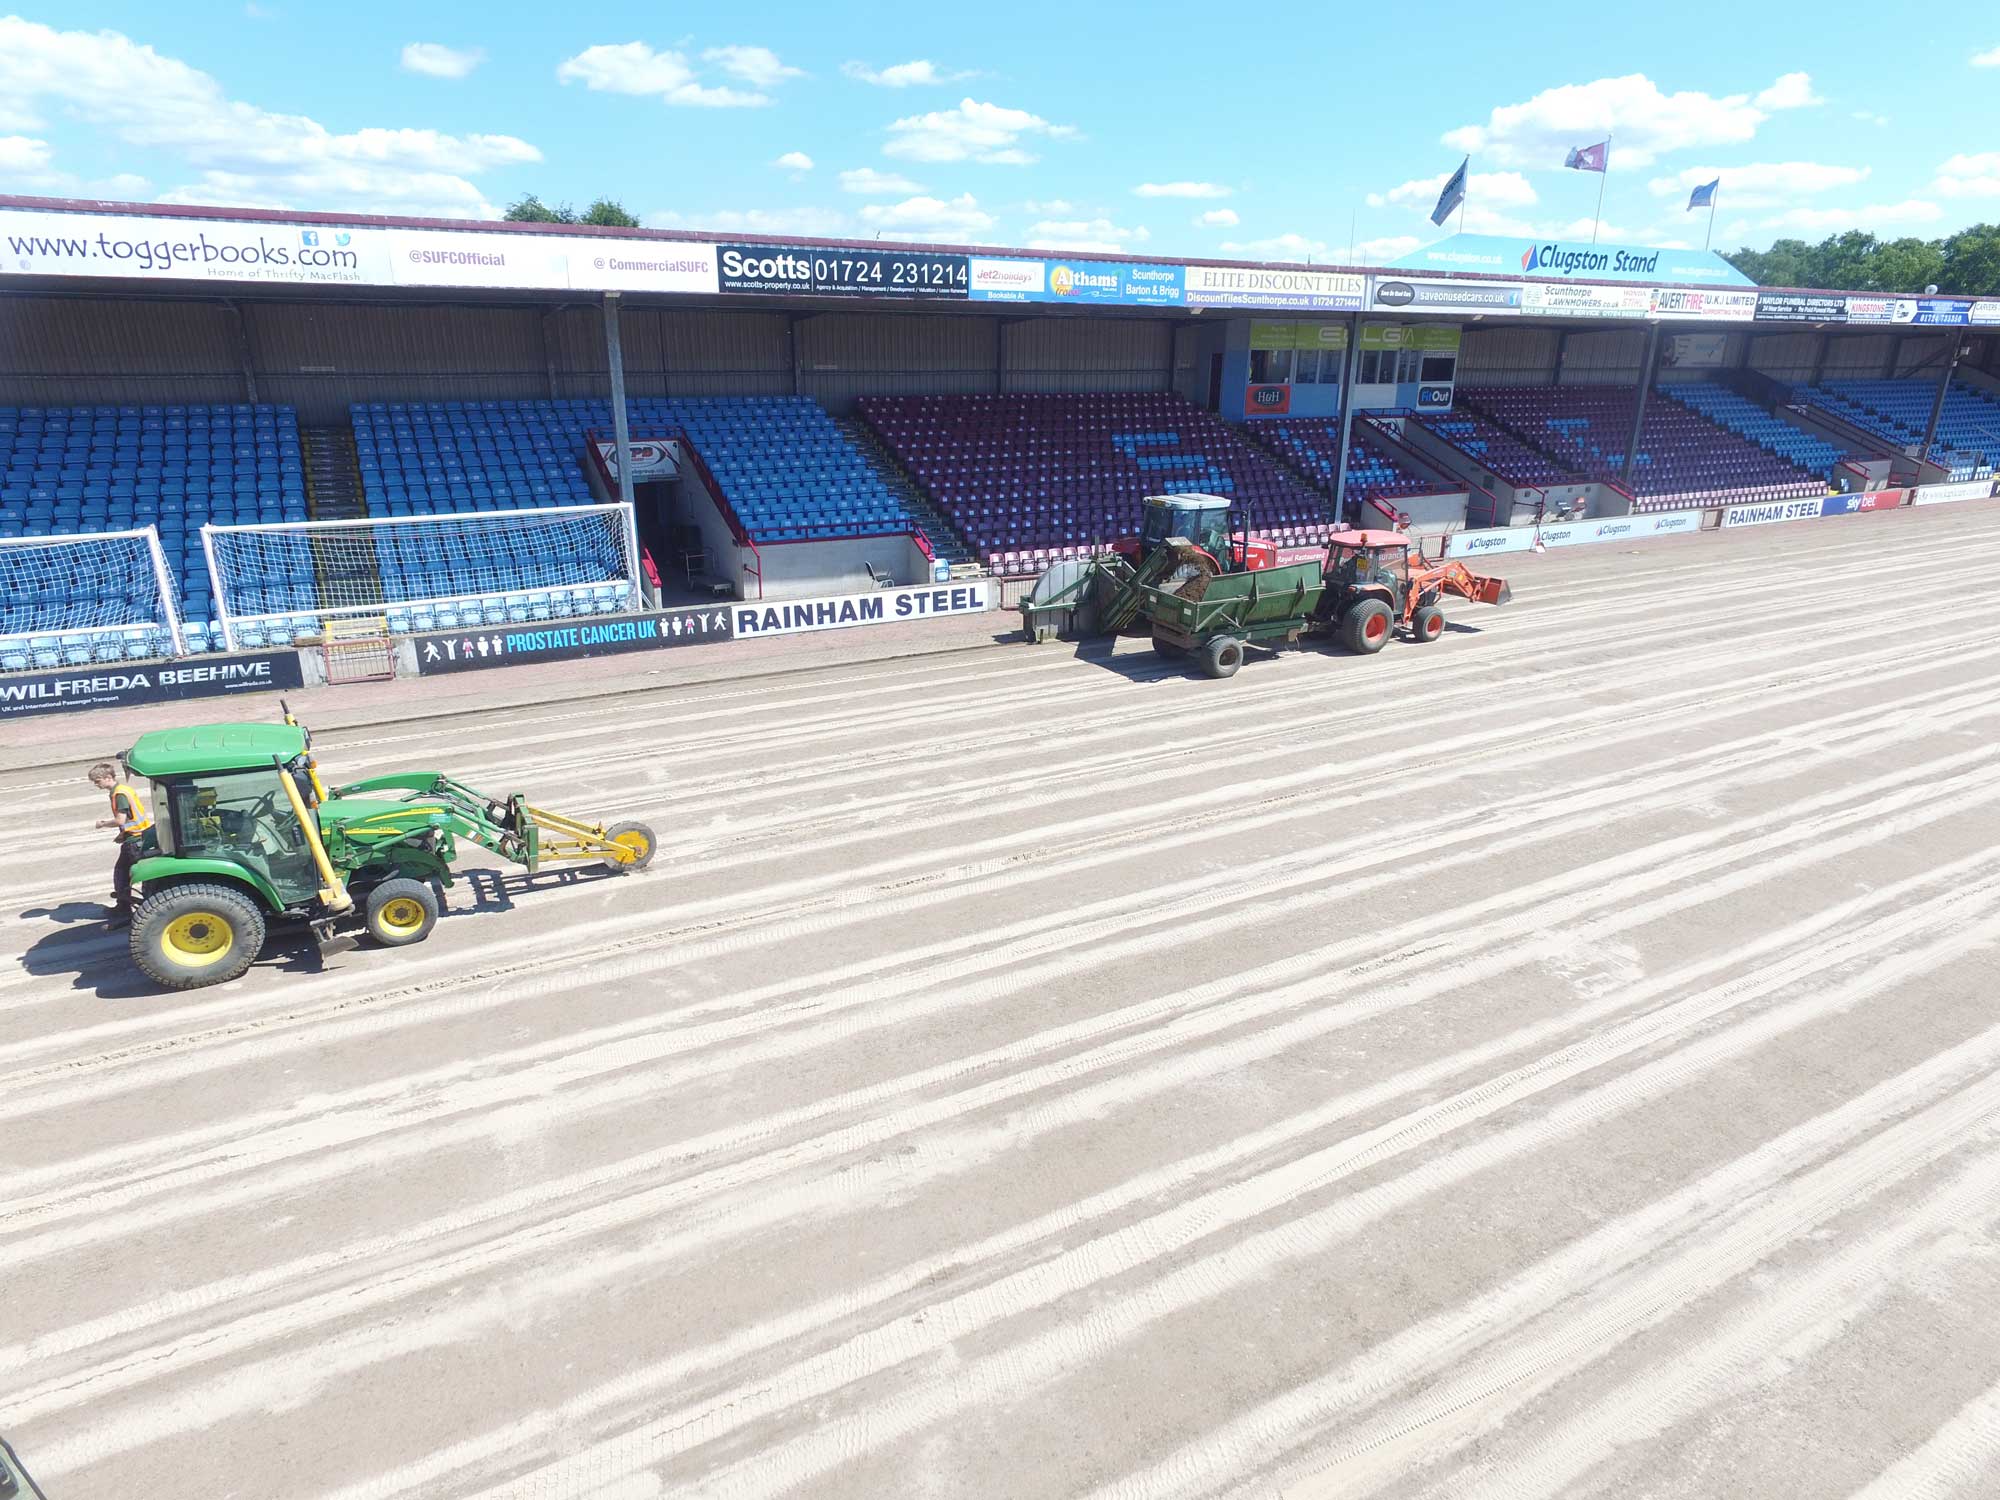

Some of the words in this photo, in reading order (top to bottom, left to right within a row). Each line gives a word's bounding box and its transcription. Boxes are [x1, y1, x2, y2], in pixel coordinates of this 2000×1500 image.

[8, 233, 357, 269] www.toggerbooks.com
[409, 250, 505, 267] @SUFCOfficial
[609, 258, 709, 273] CommercialSUFC
[723, 250, 811, 280] Scotts
[1539, 245, 1608, 274] Clugston
[1613, 250, 1659, 273] Stand
[207, 267, 244, 277] Home
[248, 268, 262, 278] of
[266, 269, 305, 281] Thrifty
[310, 271, 361, 281] MacFlash
[815, 259, 883, 283] 01724
[892, 262, 968, 285] 231214
[1056, 269, 1118, 288] Althams
[1132, 269, 1175, 282] Scunthorpe
[1203, 271, 1245, 288] ELITE
[1253, 273, 1323, 291] DISCOUNT
[1326, 277, 1362, 292] TILES
[1126, 283, 1149, 297] Barton
[1151, 285, 1158, 296] &
[1160, 286, 1180, 299] Brigg
[1420, 290, 1505, 303] saveonusedcars.co.uk
[1545, 285, 1592, 298] Scunthorpe
[1187, 293, 1309, 306] DiscountTilesScunthorpe.co.uk
[1658, 292, 1704, 310] AVERTFIRE
[1725, 296, 1755, 306] LIMITED
[1851, 303, 1885, 313] KINGSTONS
[1728, 505, 1784, 525] RAINHAM
[1785, 502, 1820, 518] STEEL
[1602, 524, 1631, 536] Clugston
[1658, 517, 1687, 529] Clugston
[1473, 537, 1506, 550] Clugston
[1540, 530, 1571, 543] Clugston
[1295, 552, 1326, 562] Restaurant
[737, 596, 884, 633] RAINHAM
[895, 587, 984, 616] STEEL
[506, 628, 579, 654] PROSTATE
[580, 623, 637, 645] CANCER
[637, 619, 657, 639] UK
[0, 673, 151, 702] WILFREDA
[159, 661, 271, 687] BEEHIVE
[25, 699, 62, 710] International
[63, 697, 91, 707] Passenger
[92, 694, 119, 704] Transport
